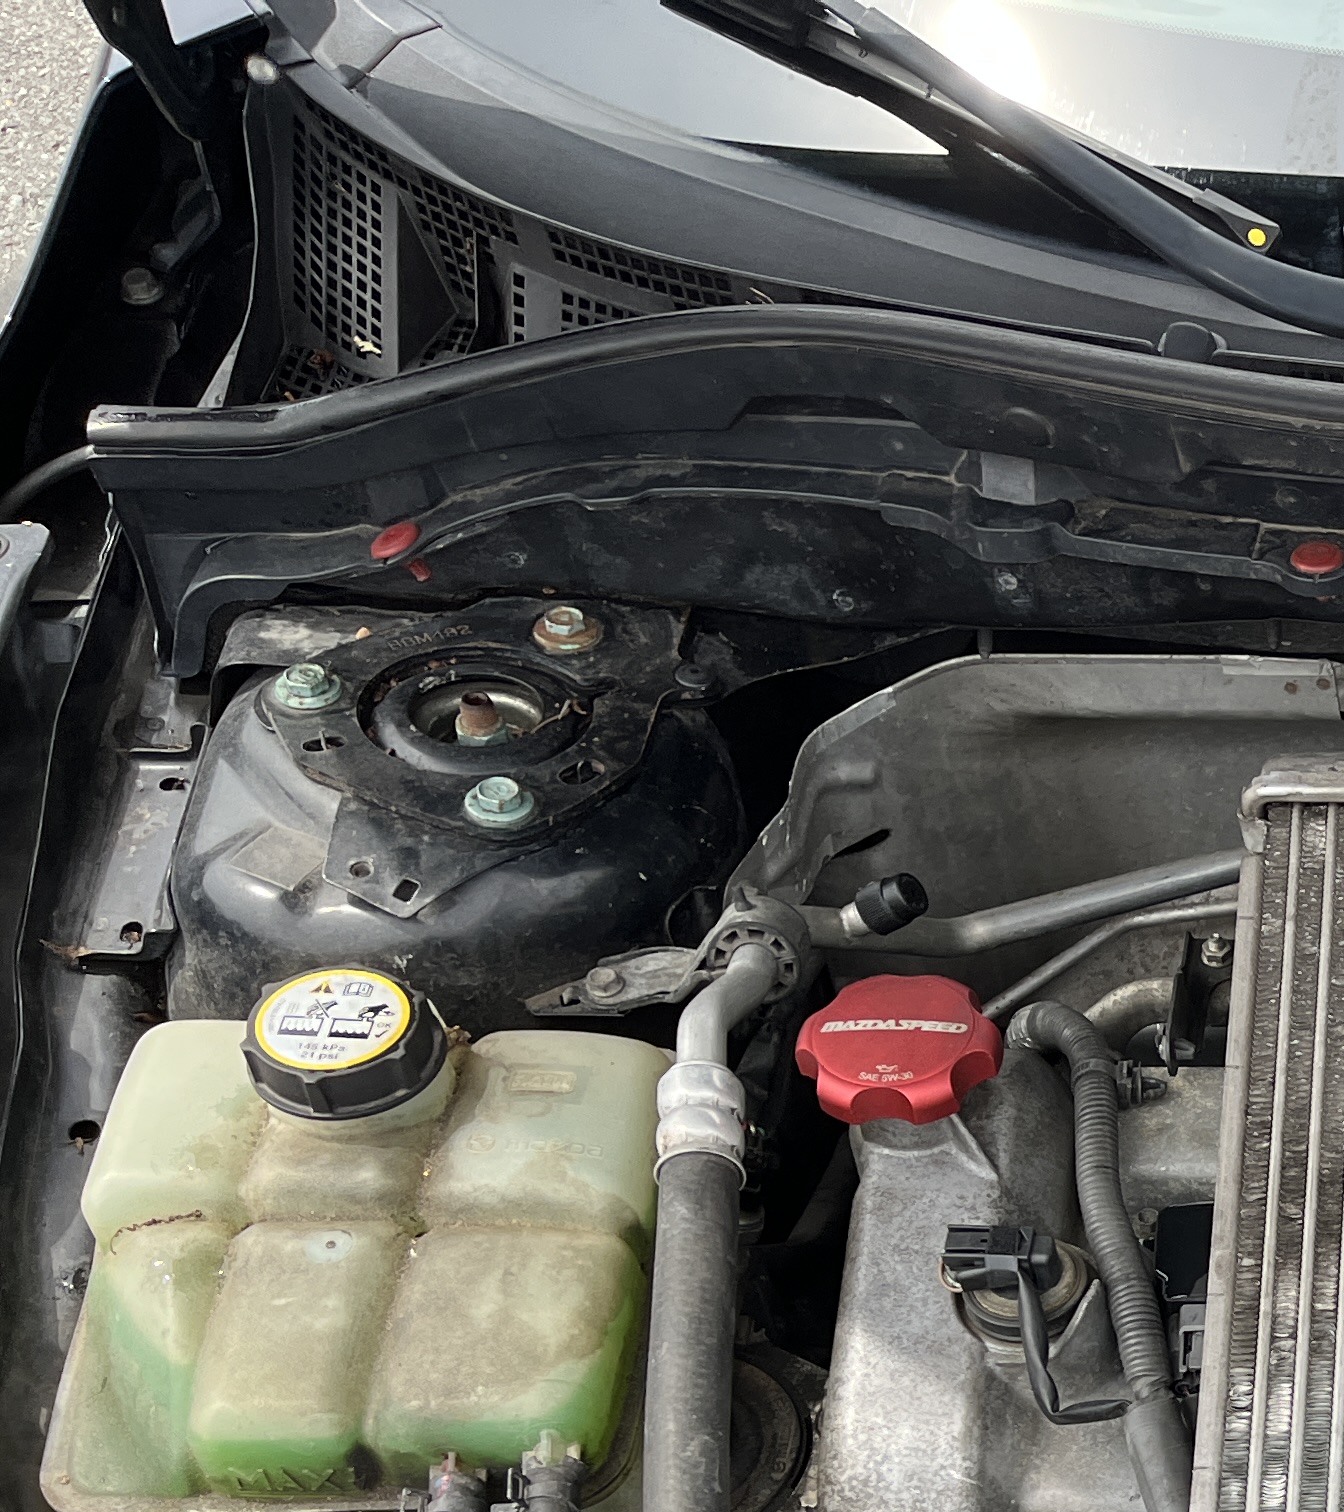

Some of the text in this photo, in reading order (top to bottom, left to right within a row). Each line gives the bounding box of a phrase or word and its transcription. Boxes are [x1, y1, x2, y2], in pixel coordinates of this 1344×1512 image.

[376, 1021, 392, 1029] OK
[820, 1019, 969, 1034] MAZDASPEED
[322, 1042, 346, 1052] kPa
[318, 1052, 340, 1061] psi
[858, 1070, 914, 1083] SAE 5W-30
